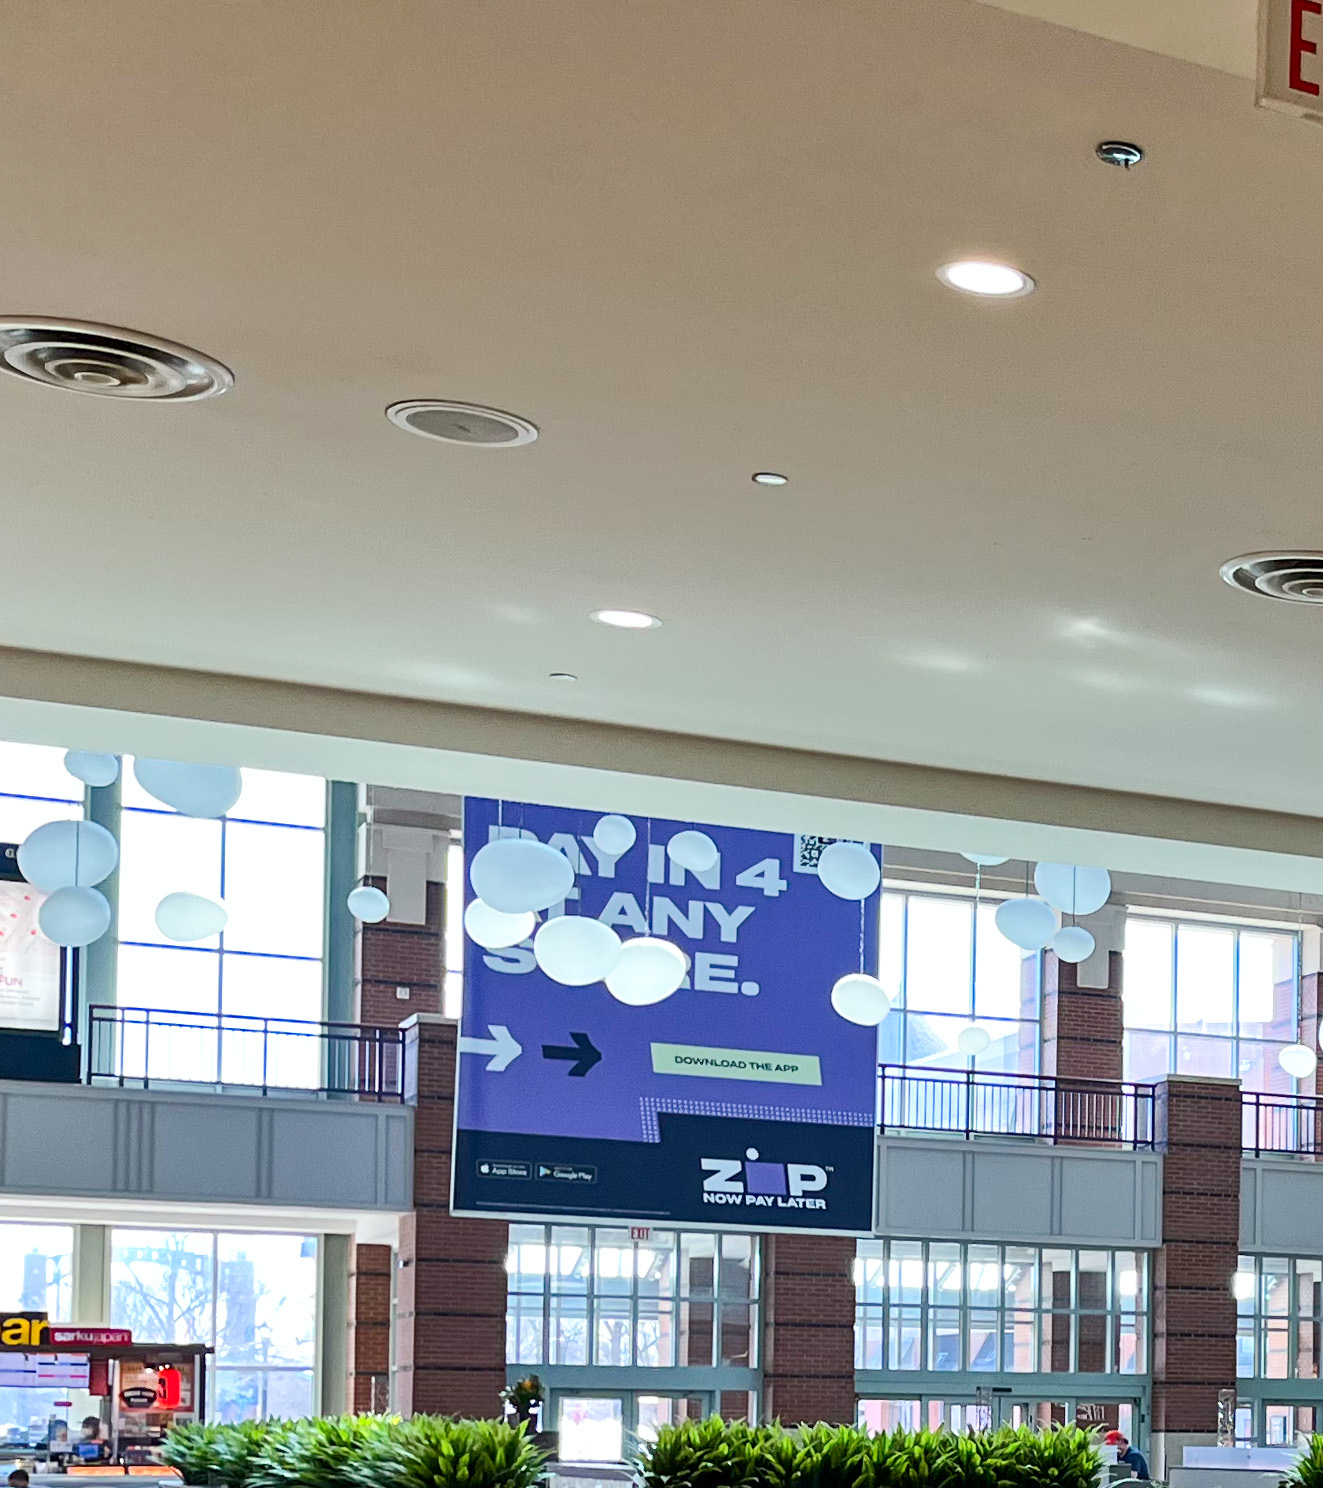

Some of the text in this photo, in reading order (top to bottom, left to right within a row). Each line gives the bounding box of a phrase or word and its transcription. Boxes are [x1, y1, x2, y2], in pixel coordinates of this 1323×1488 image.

[735, 858, 787, 897] 4
[600, 891, 756, 943] ANY
[674, 1055, 799, 1073] DOWNLOAD THE APP
[703, 1193, 827, 1210] NOW PAY LATER
[631, 1226, 650, 1241] EXIT
